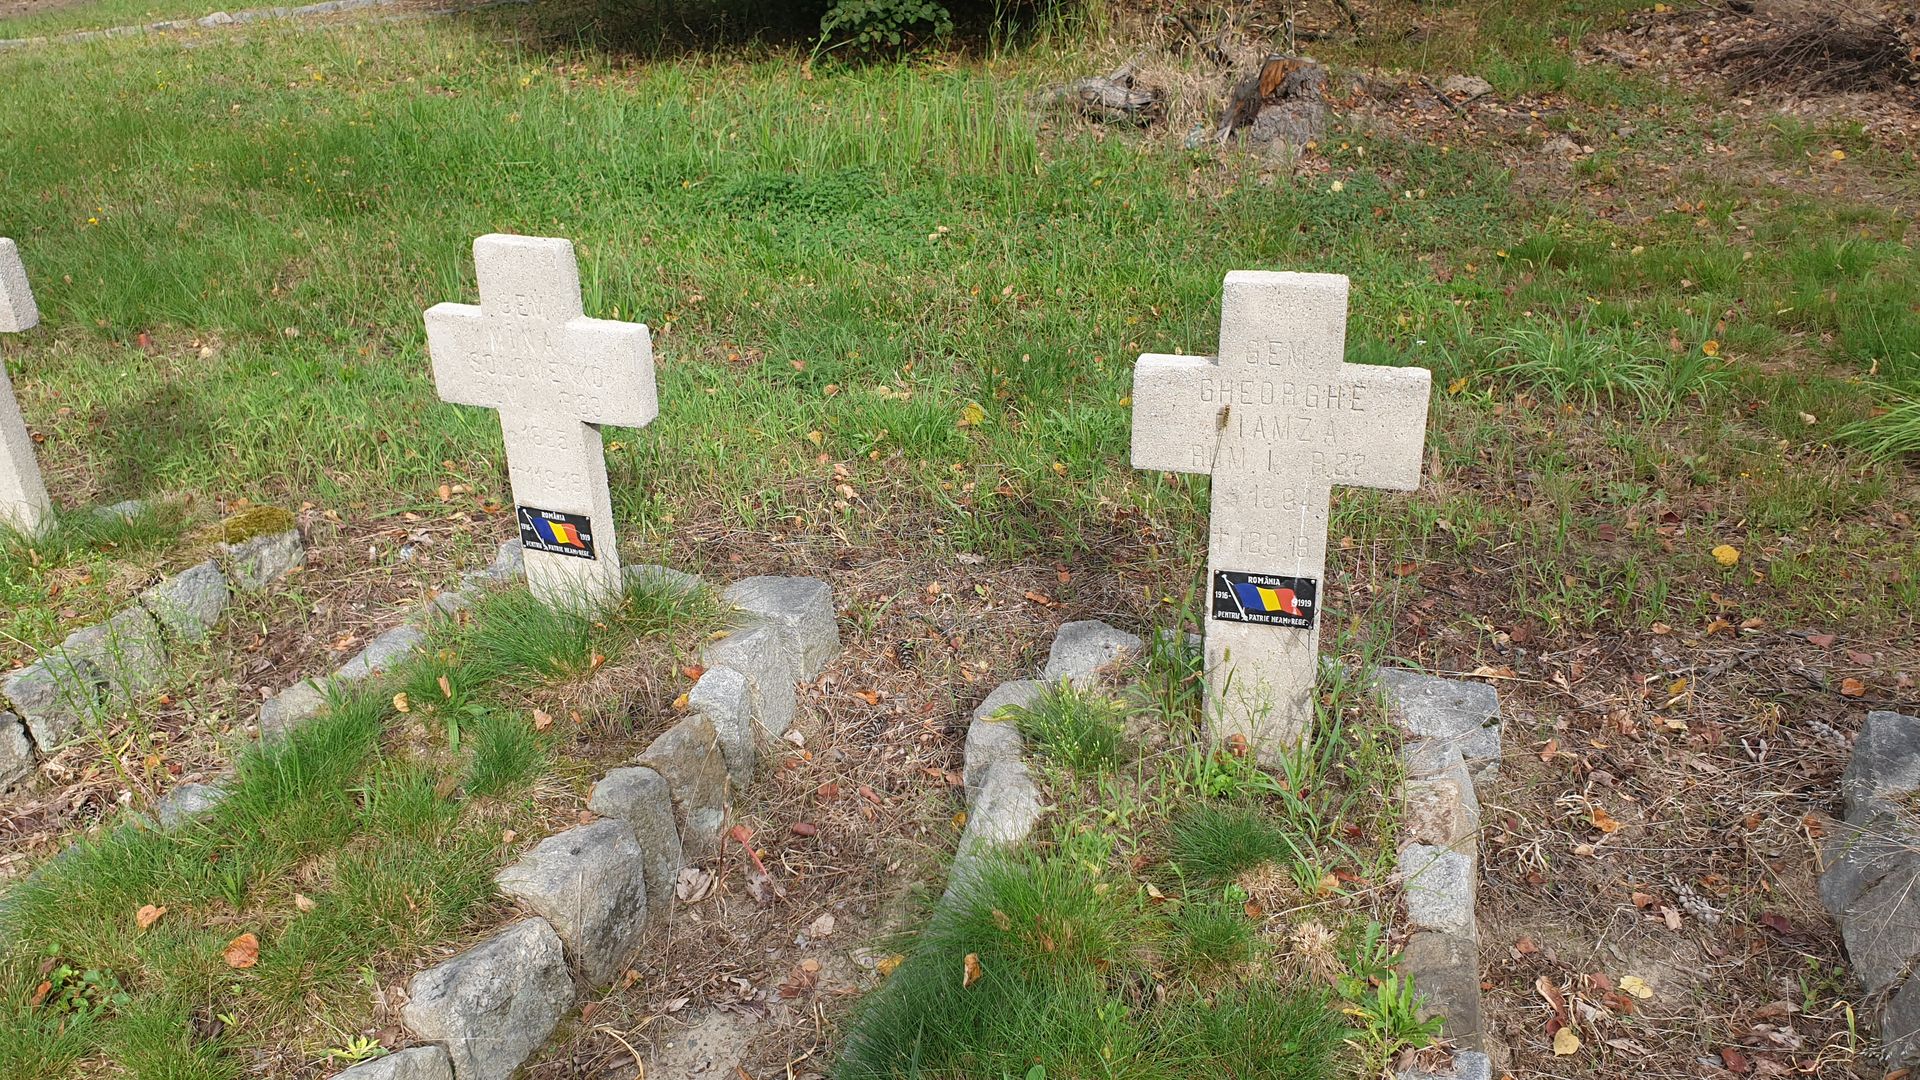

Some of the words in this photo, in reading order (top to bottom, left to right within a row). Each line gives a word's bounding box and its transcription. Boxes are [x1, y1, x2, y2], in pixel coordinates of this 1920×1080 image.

[1200, 378, 1367, 412] GHEORGHE
[1248, 576, 1280, 586] ROMÂNIA
[1298, 599, 1312, 607] 1919
[1217, 610, 1240, 620] PENTRU
[1248, 614, 1269, 624] PATRIE
